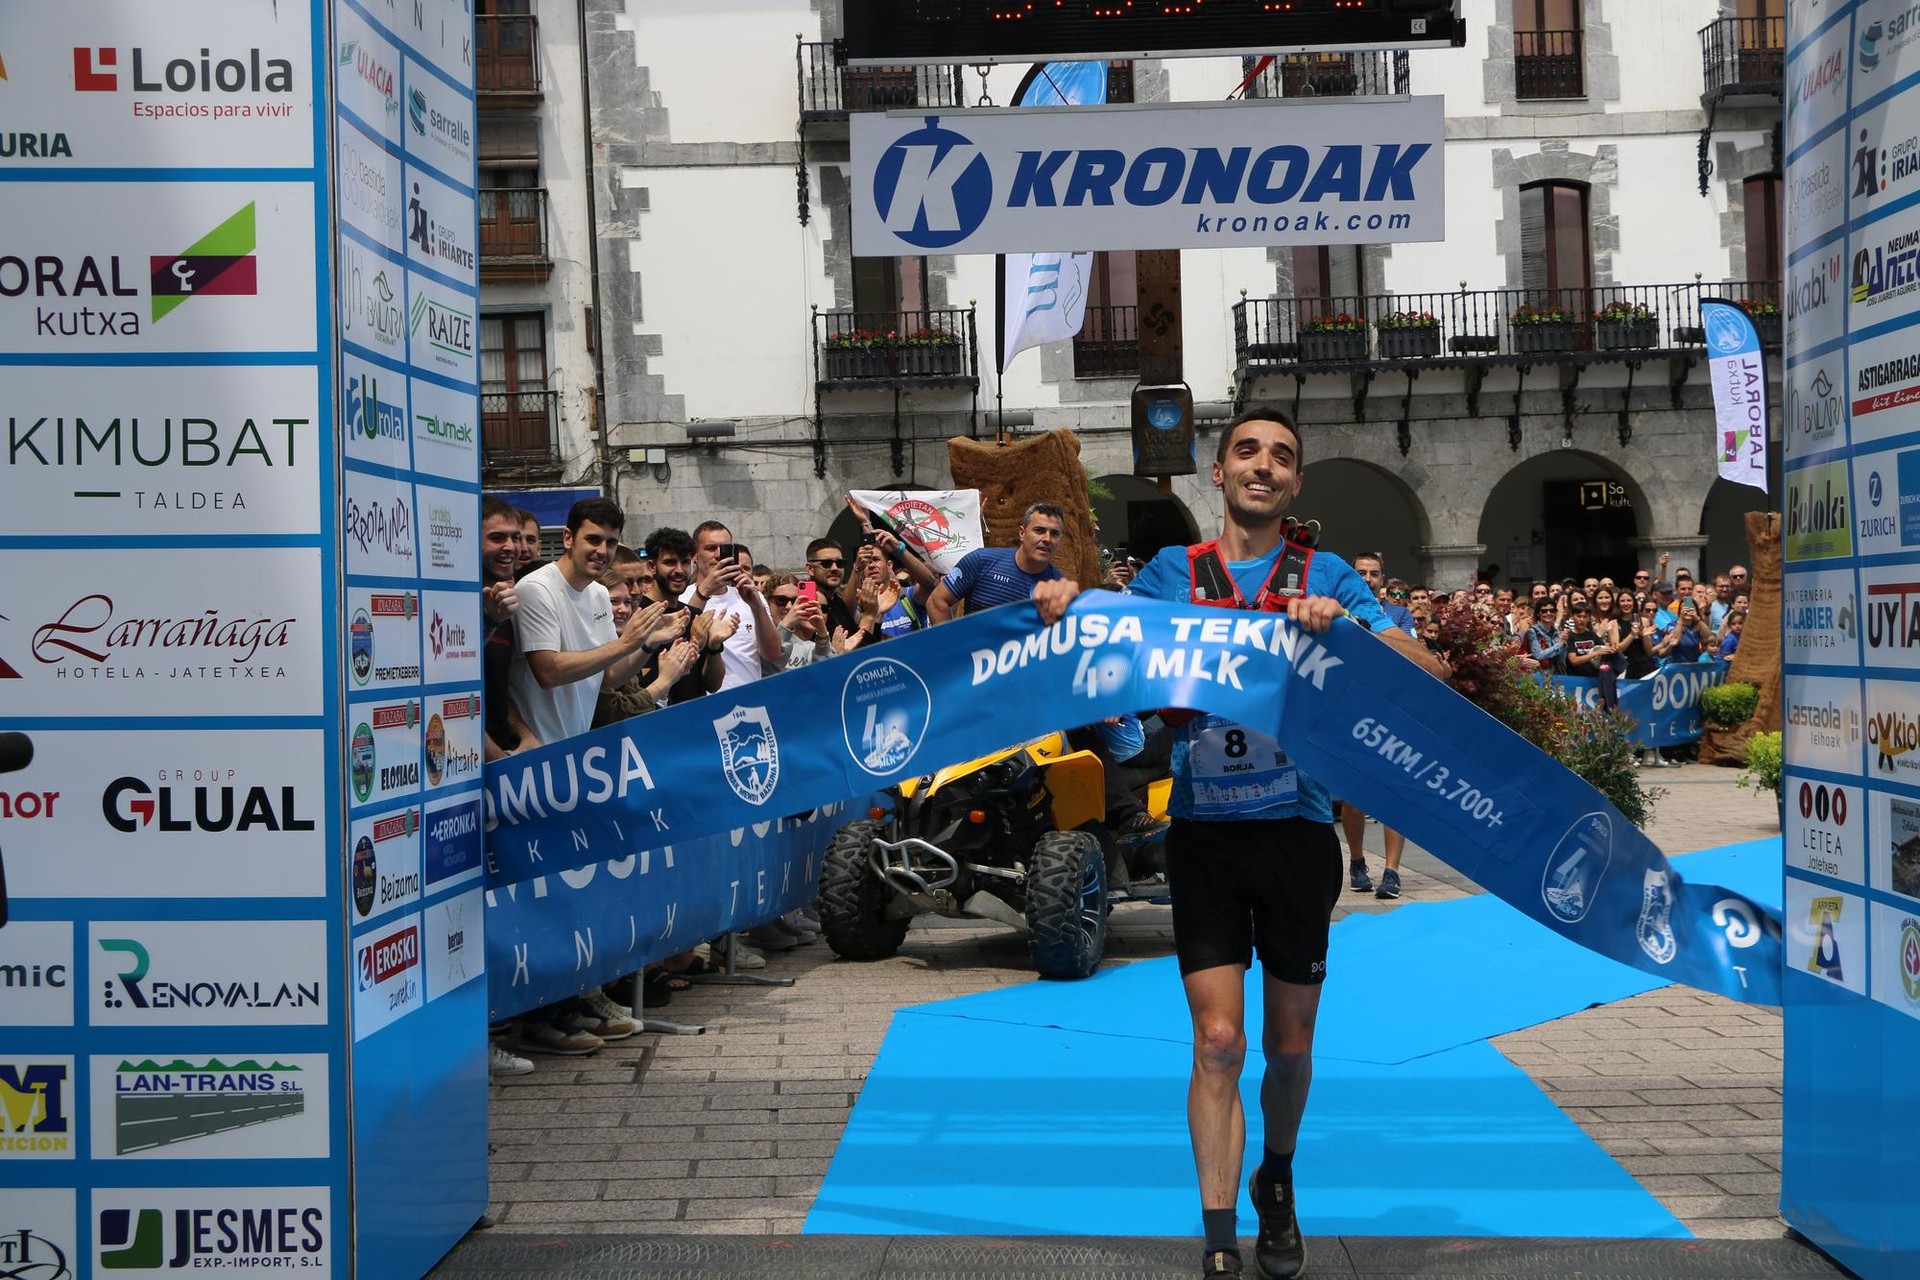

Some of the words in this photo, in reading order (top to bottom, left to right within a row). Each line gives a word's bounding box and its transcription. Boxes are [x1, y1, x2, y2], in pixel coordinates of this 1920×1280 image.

[132, 47, 293, 92] Loiola
[356, 46, 394, 98] ULACIA
[1803, 48, 1842, 101] ULACIA
[133, 102, 209, 120] Espacios
[213, 103, 251, 120] para
[256, 101, 293, 117] vivir
[430, 108, 470, 147] sarralle
[1892, 136, 1918, 158] GRUPO
[1006, 142, 1433, 208] KRONOAK
[1892, 150, 1920, 182] IRIA
[1196, 210, 1411, 233] kronoak.com
[438, 239, 474, 270] IRIARTE
[1888, 230, 1920, 254] NEUMA
[37, 306, 140, 335] kutxa
[429, 306, 471, 350] RAIZE
[8, 417, 310, 467] KIMUBAT
[134, 491, 247, 509] TALDEA
[1787, 480, 1845, 537] Beloki
[1860, 515, 1897, 538] ZURICH
[32, 594, 296, 664] Larrañaga
[971, 614, 1144, 687] DOMUSA
[1170, 616, 1344, 691] TEKNIK
[56, 667, 145, 679] HOTELA
[169, 666, 287, 679] JATETXEA
[856, 664, 896, 684] DOMUSA
[1146, 647, 1249, 691] MLK
[1224, 729, 1248, 759] 8
[158, 769, 236, 781] GROUP
[1222, 762, 1255, 773] BORJA
[102, 776, 315, 833] GLUAL
[438, 811, 477, 843] ERRONKA
[1803, 827, 1843, 856] LETEA
[1808, 853, 1839, 876] Jatetxea
[380, 873, 419, 904] Beizama
[376, 934, 415, 976] EROSKI
[389, 981, 417, 1012] zurekin
[116, 1073, 275, 1092] LAN-TRANS
[281, 1081, 303, 1091] S.L.
[169, 1207, 323, 1268] JESMES
